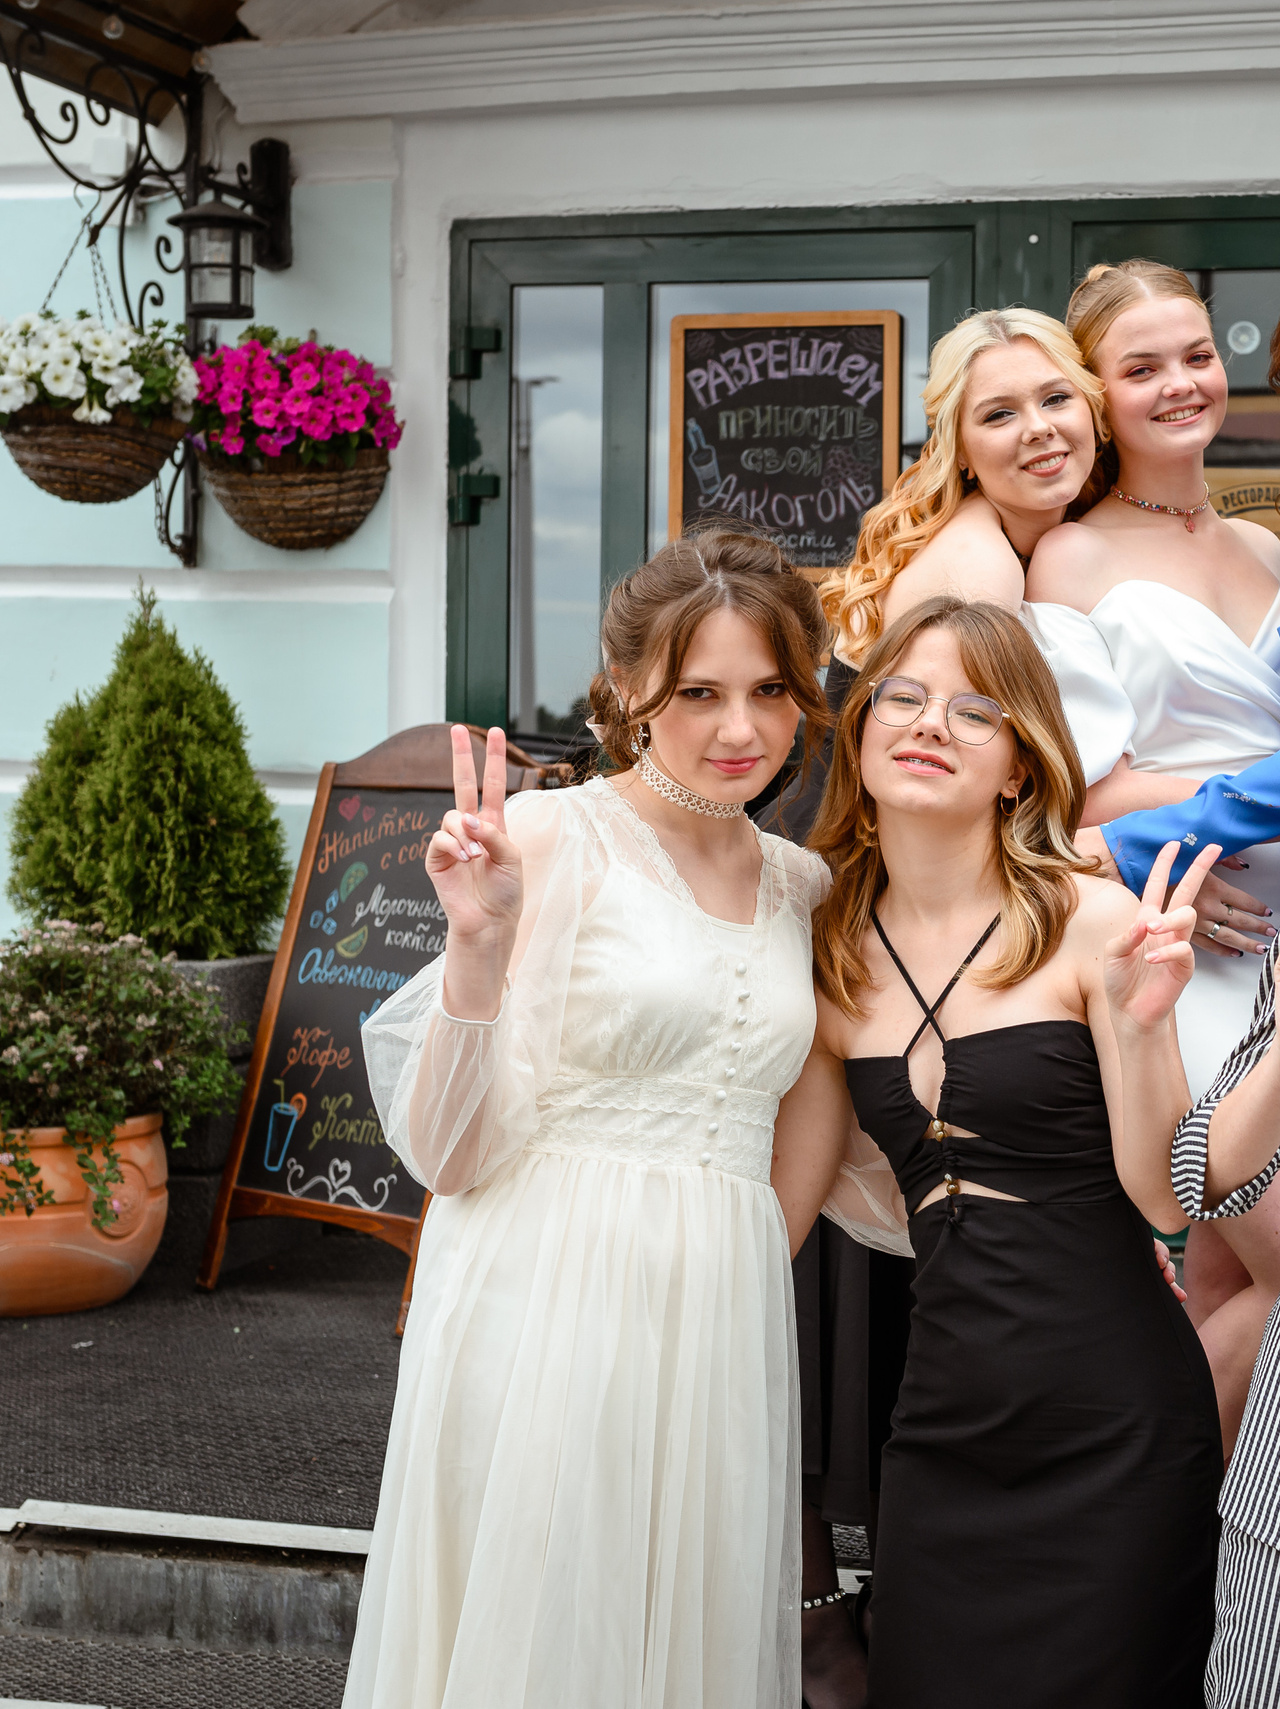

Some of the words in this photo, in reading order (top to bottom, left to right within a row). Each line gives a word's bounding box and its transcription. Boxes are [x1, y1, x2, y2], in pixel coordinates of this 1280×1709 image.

[719, 404, 879, 441] ПРИНОСИТЬ
[318, 807, 430, 874] Напитки
[398, 832, 433, 865] соб
[385, 922, 447, 953] коктей
[280, 1027, 353, 1089] Кофе
